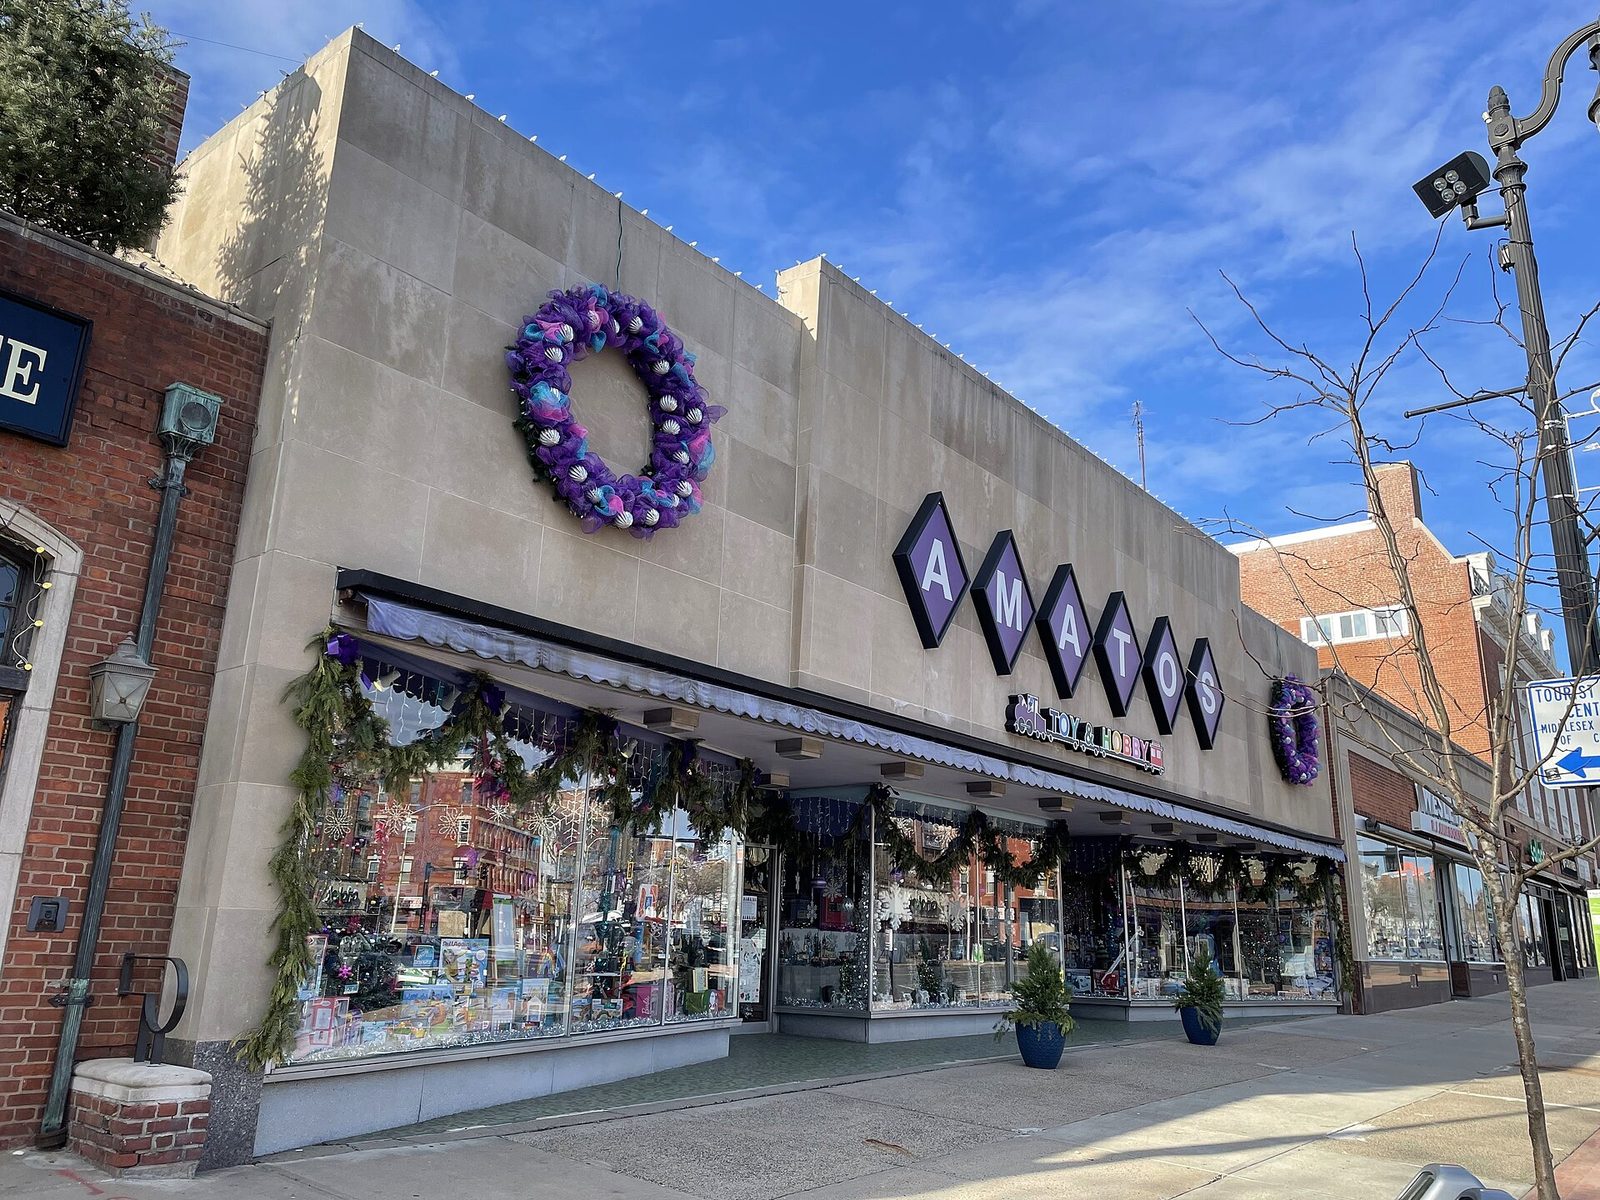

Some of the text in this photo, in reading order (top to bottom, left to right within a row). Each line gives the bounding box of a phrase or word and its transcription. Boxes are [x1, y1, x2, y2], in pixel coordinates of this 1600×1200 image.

[0, 334, 48, 405] E
[921, 538, 1216, 715] AMATOS
[1535, 685, 1594, 703] TOURST
[1050, 708, 1149, 763] TOY & HOBBY
[1540, 720, 1595, 734] MIDLESEX
[1560, 735, 1572, 745] OF
